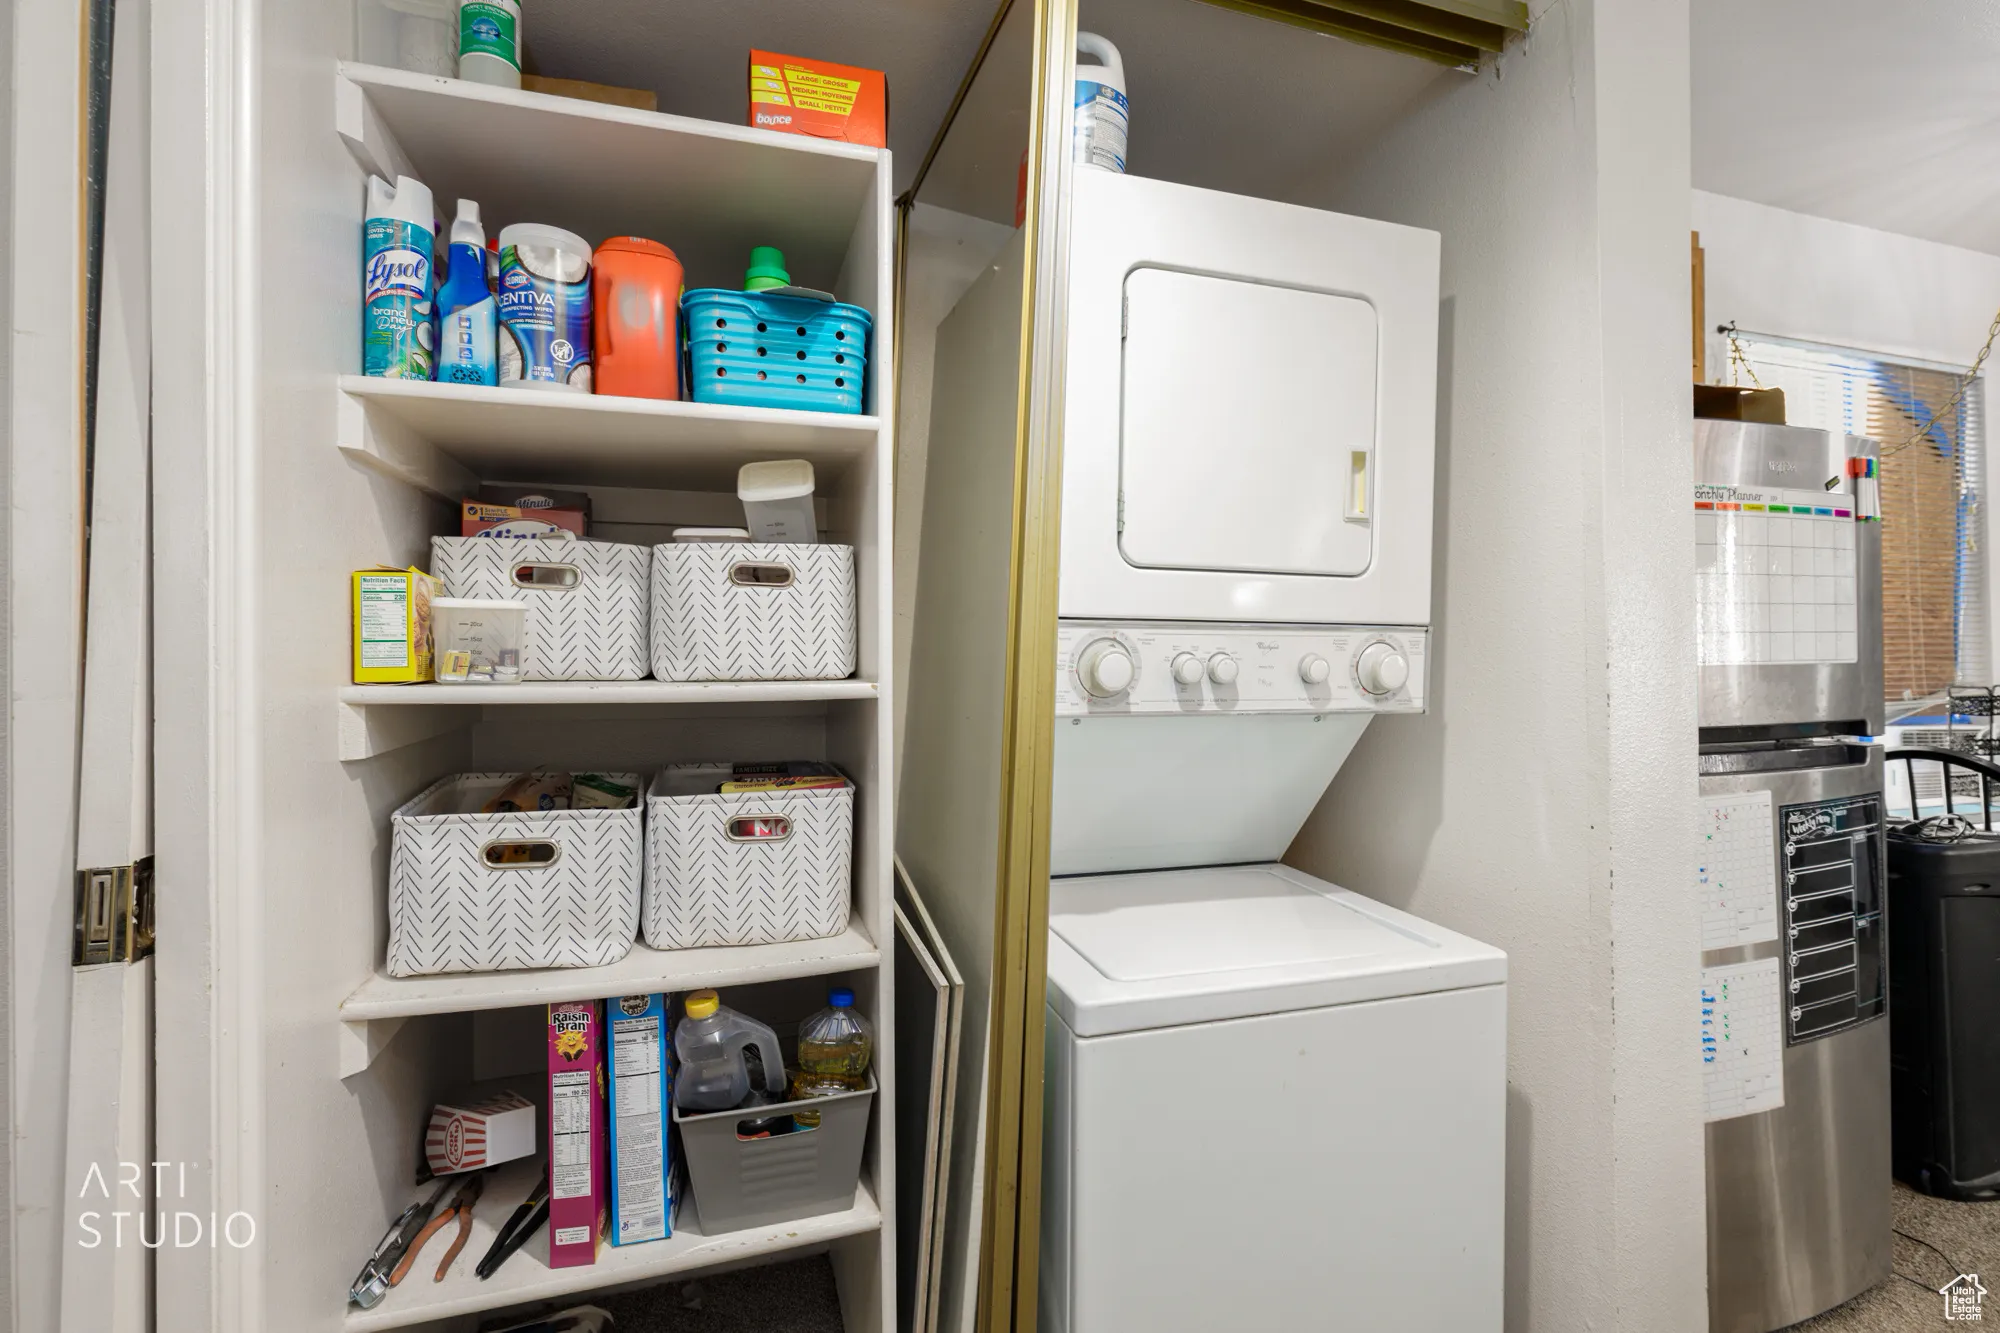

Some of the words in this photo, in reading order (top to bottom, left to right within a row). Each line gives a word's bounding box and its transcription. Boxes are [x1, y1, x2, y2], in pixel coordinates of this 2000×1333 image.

[796, 75, 819, 84] LARGE
[822, 79, 848, 89] GROSSE
[792, 86, 818, 96] MEDIUM
[822, 91, 853, 101] MOYENNE
[798, 100, 820, 109] SMALL
[824, 103, 847, 113] PETITE
[367, 253, 426, 290] Lysol
[505, 275, 527, 285] CLOROX
[373, 306, 407, 318] brand
[391, 316, 417, 327] new
[1695, 488, 1724, 502] onthly
[1727, 488, 1763, 501] Planner
[515, 498, 554, 509] Minute
[1791, 818, 1817, 834] Weekly
[552, 1012, 590, 1025] Raisin
[556, 1022, 587, 1033] Bran
